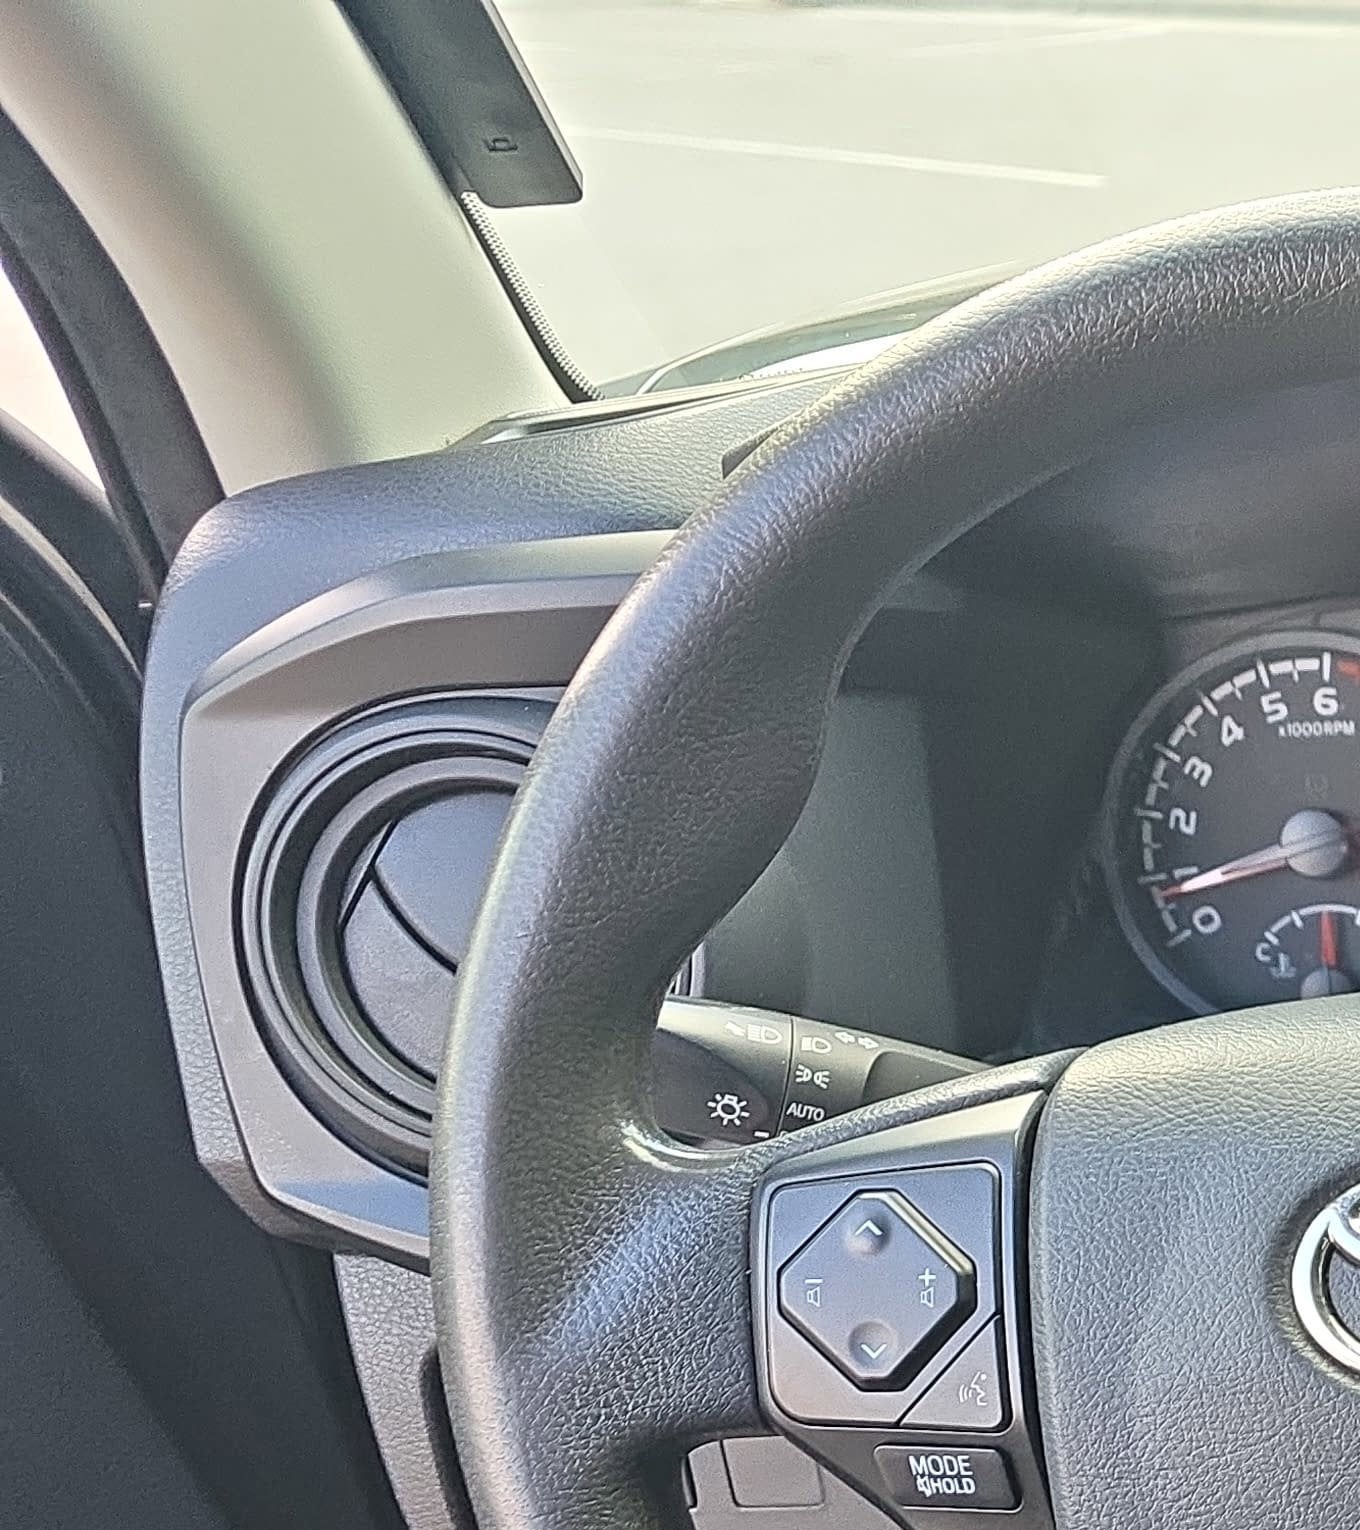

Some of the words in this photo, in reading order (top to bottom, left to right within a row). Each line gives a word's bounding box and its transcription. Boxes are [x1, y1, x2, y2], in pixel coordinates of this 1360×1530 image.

[1261, 692, 1287, 723] 5
[1313, 688, 1339, 715] 6
[1220, 717, 1245, 746] 4
[1184, 756, 1213, 787] 3
[1170, 808, 1197, 835] 2
[1192, 904, 1221, 935] 0
[786, 1101, 825, 1121] AUTO
[909, 1455, 973, 1477] MODE
[930, 1475, 976, 1495] HOLD
